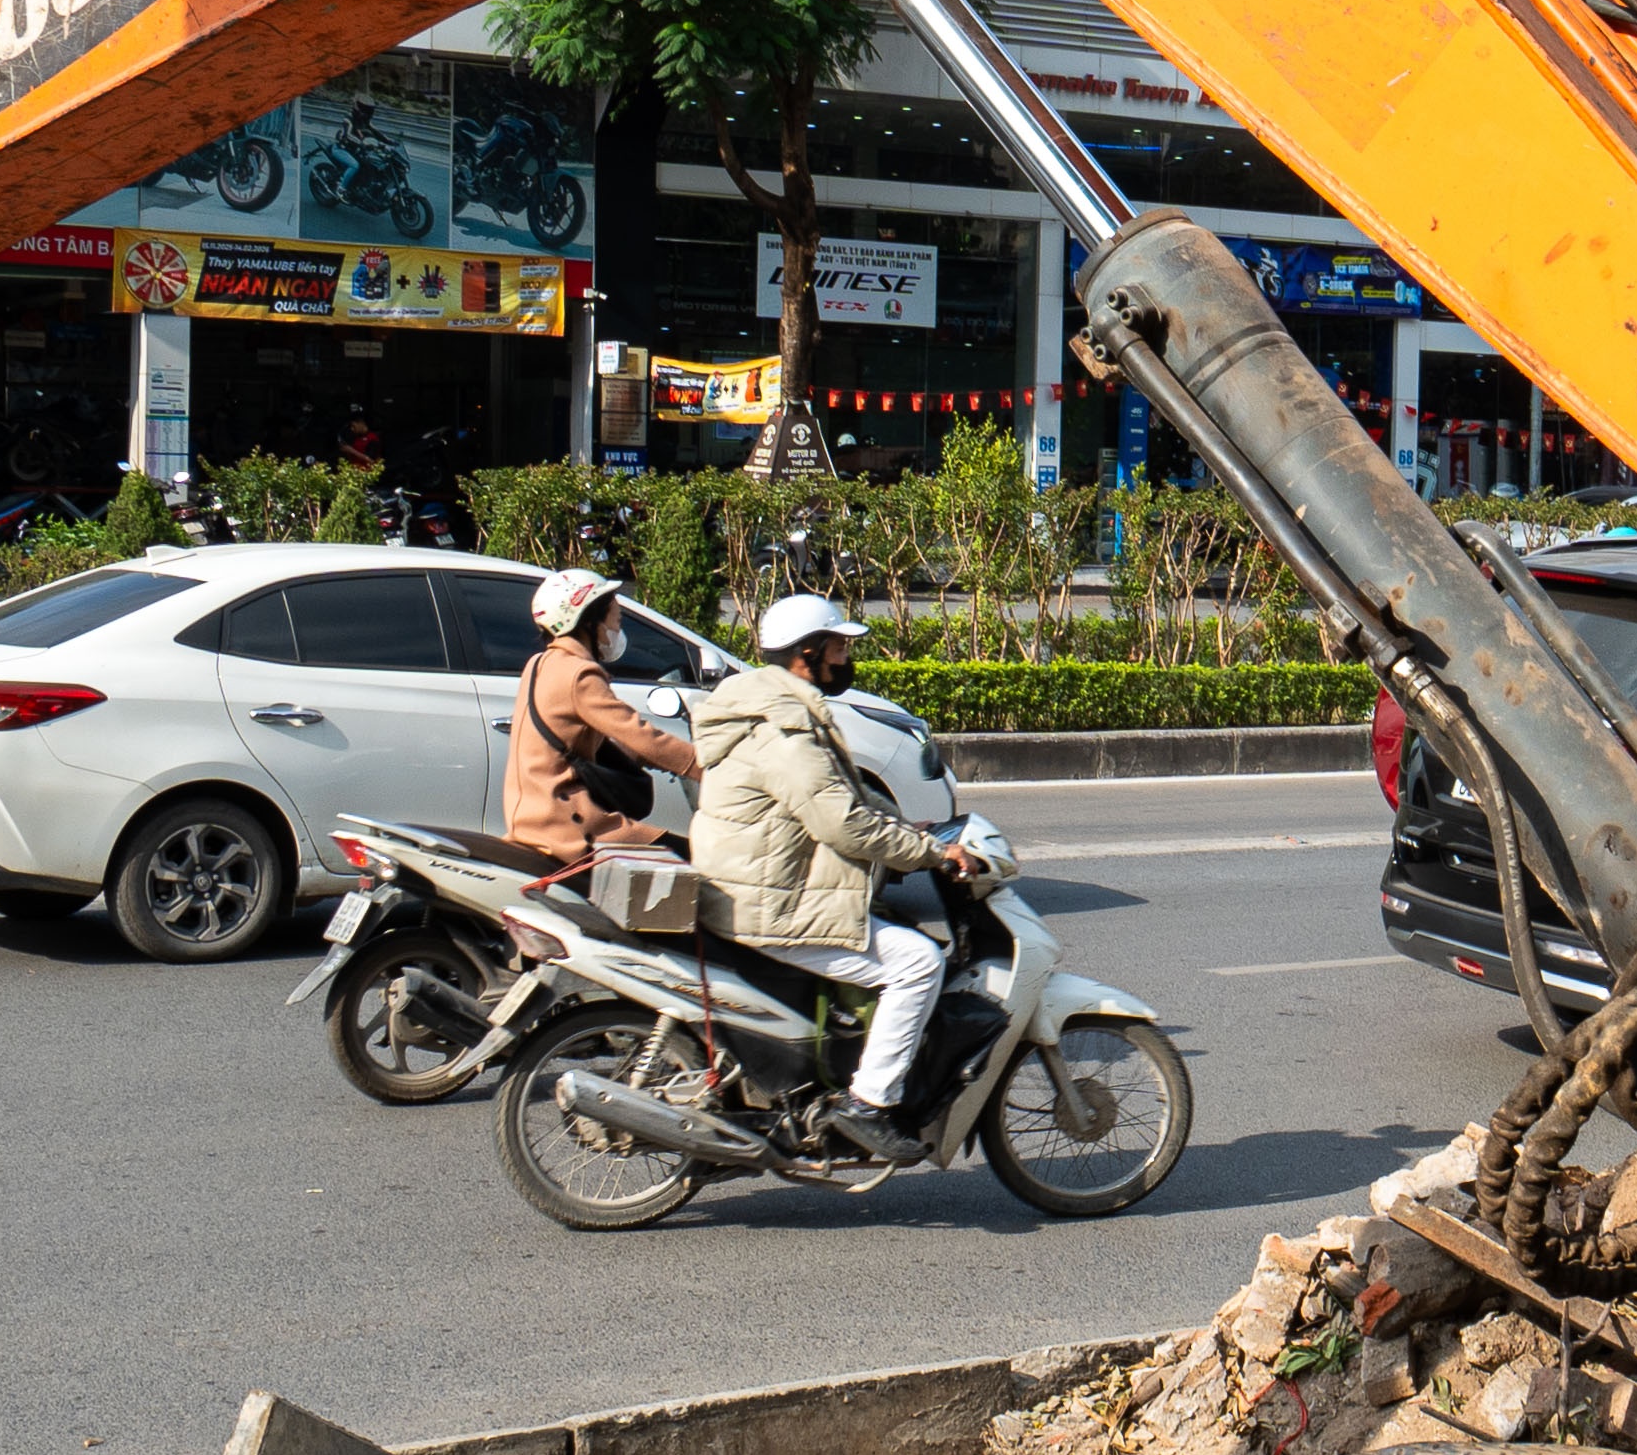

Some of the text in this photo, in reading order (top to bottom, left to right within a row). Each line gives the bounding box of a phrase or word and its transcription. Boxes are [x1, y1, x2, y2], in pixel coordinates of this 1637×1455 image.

[1024, 68, 1117, 96] amaha
[1124, 77, 1190, 104] Town
[54, 235, 93, 256] TÂM
[97, 241, 114, 256] B
[208, 256, 234, 269] Thay
[237, 257, 295, 272] YAMALUBE
[319, 263, 336, 276] tay
[872, 258, 888, 269] NAM
[201, 271, 337, 300] NHẬN NGAY
[823, 299, 870, 312] TCX
[1039, 435, 1056, 453] 68
[1398, 449, 1413, 465] 68
[429, 859, 497, 882] VISION
